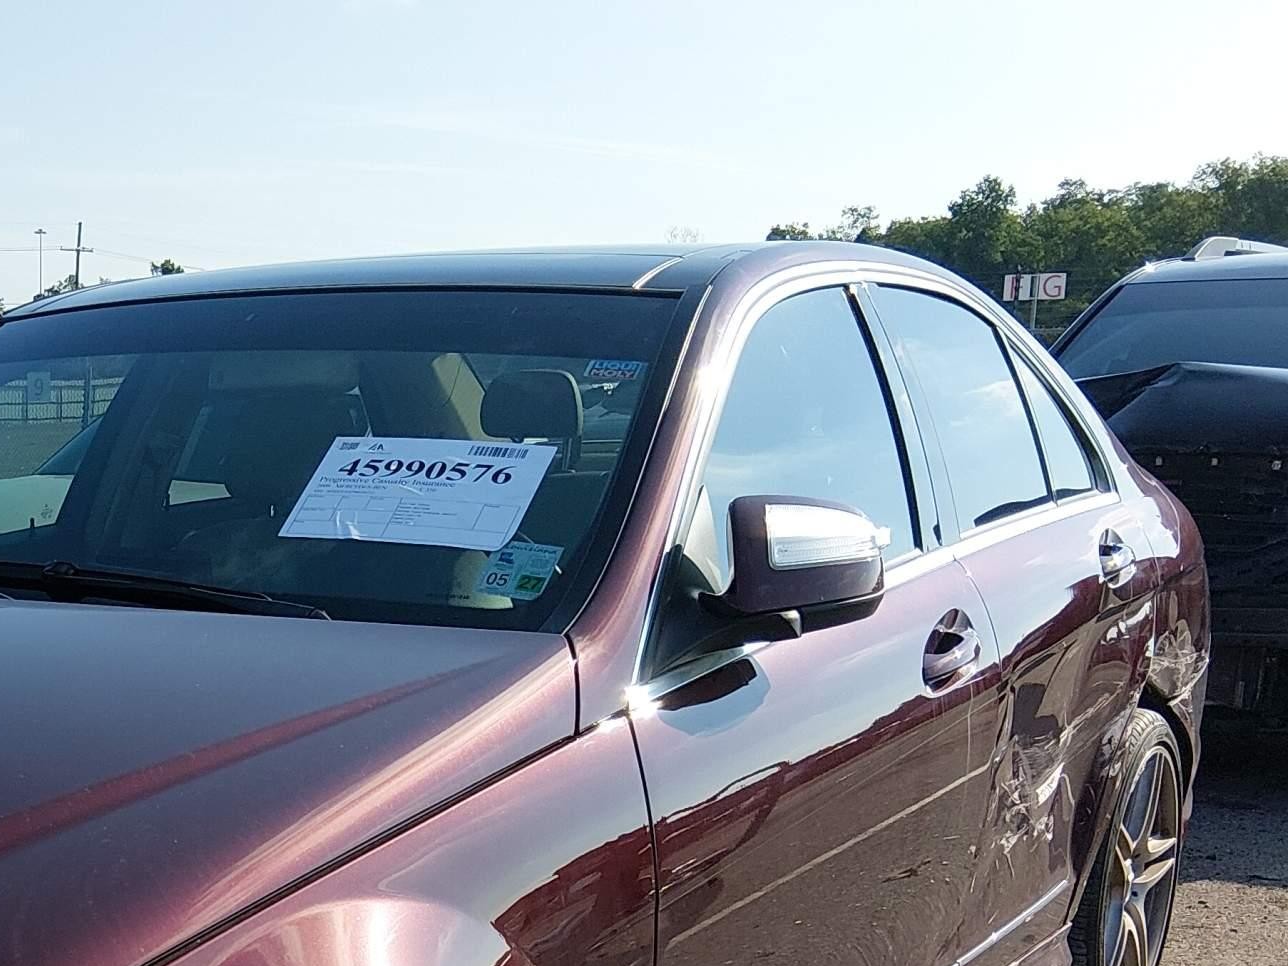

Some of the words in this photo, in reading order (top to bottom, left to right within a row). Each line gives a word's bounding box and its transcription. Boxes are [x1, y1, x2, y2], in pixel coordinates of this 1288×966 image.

[1043, 274, 1062, 298] G
[590, 368, 634, 379] MOLY
[34, 378, 44, 396] 9
[338, 458, 517, 485] 45990576
[486, 572, 509, 586] 05
[518, 576, 541, 590] 27
